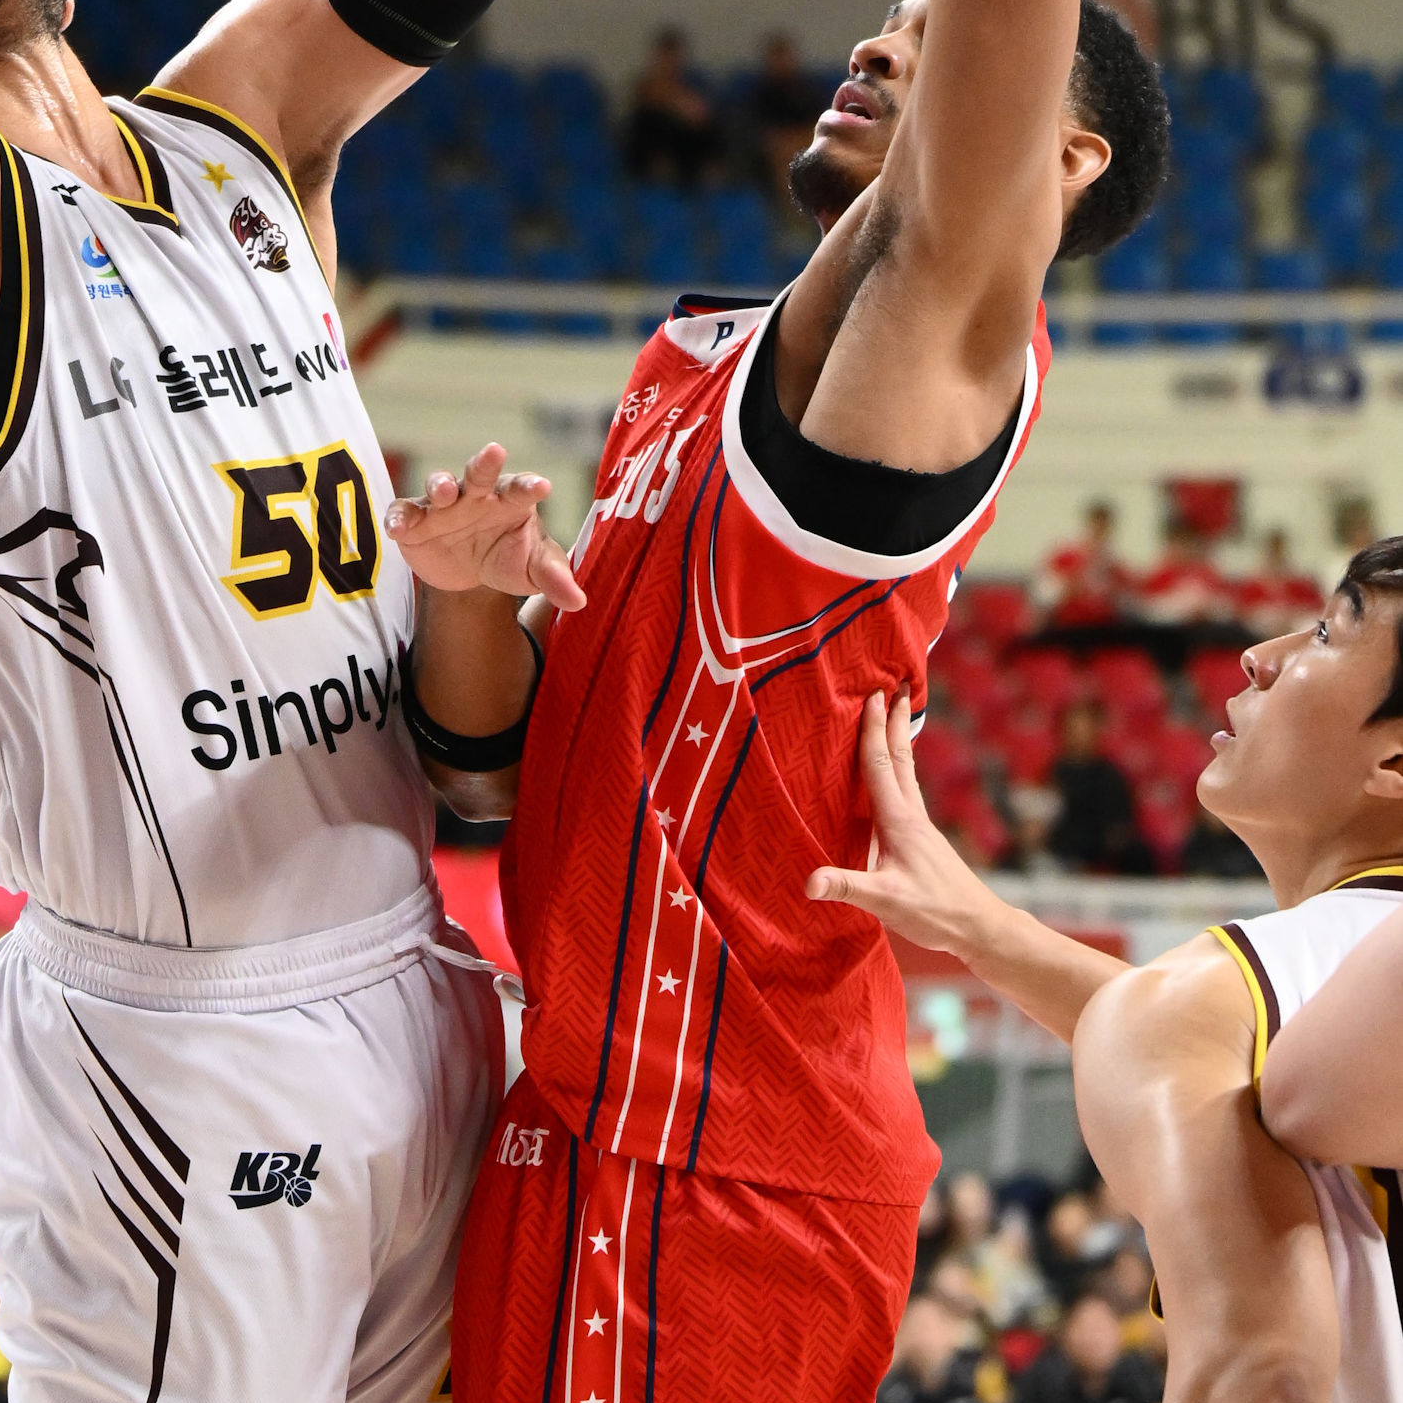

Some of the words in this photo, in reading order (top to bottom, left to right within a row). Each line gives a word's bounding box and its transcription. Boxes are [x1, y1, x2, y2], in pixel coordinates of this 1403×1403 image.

[710, 321, 735, 351] P
[211, 439, 384, 621] 50
[229, 1144, 322, 1210] KBL
